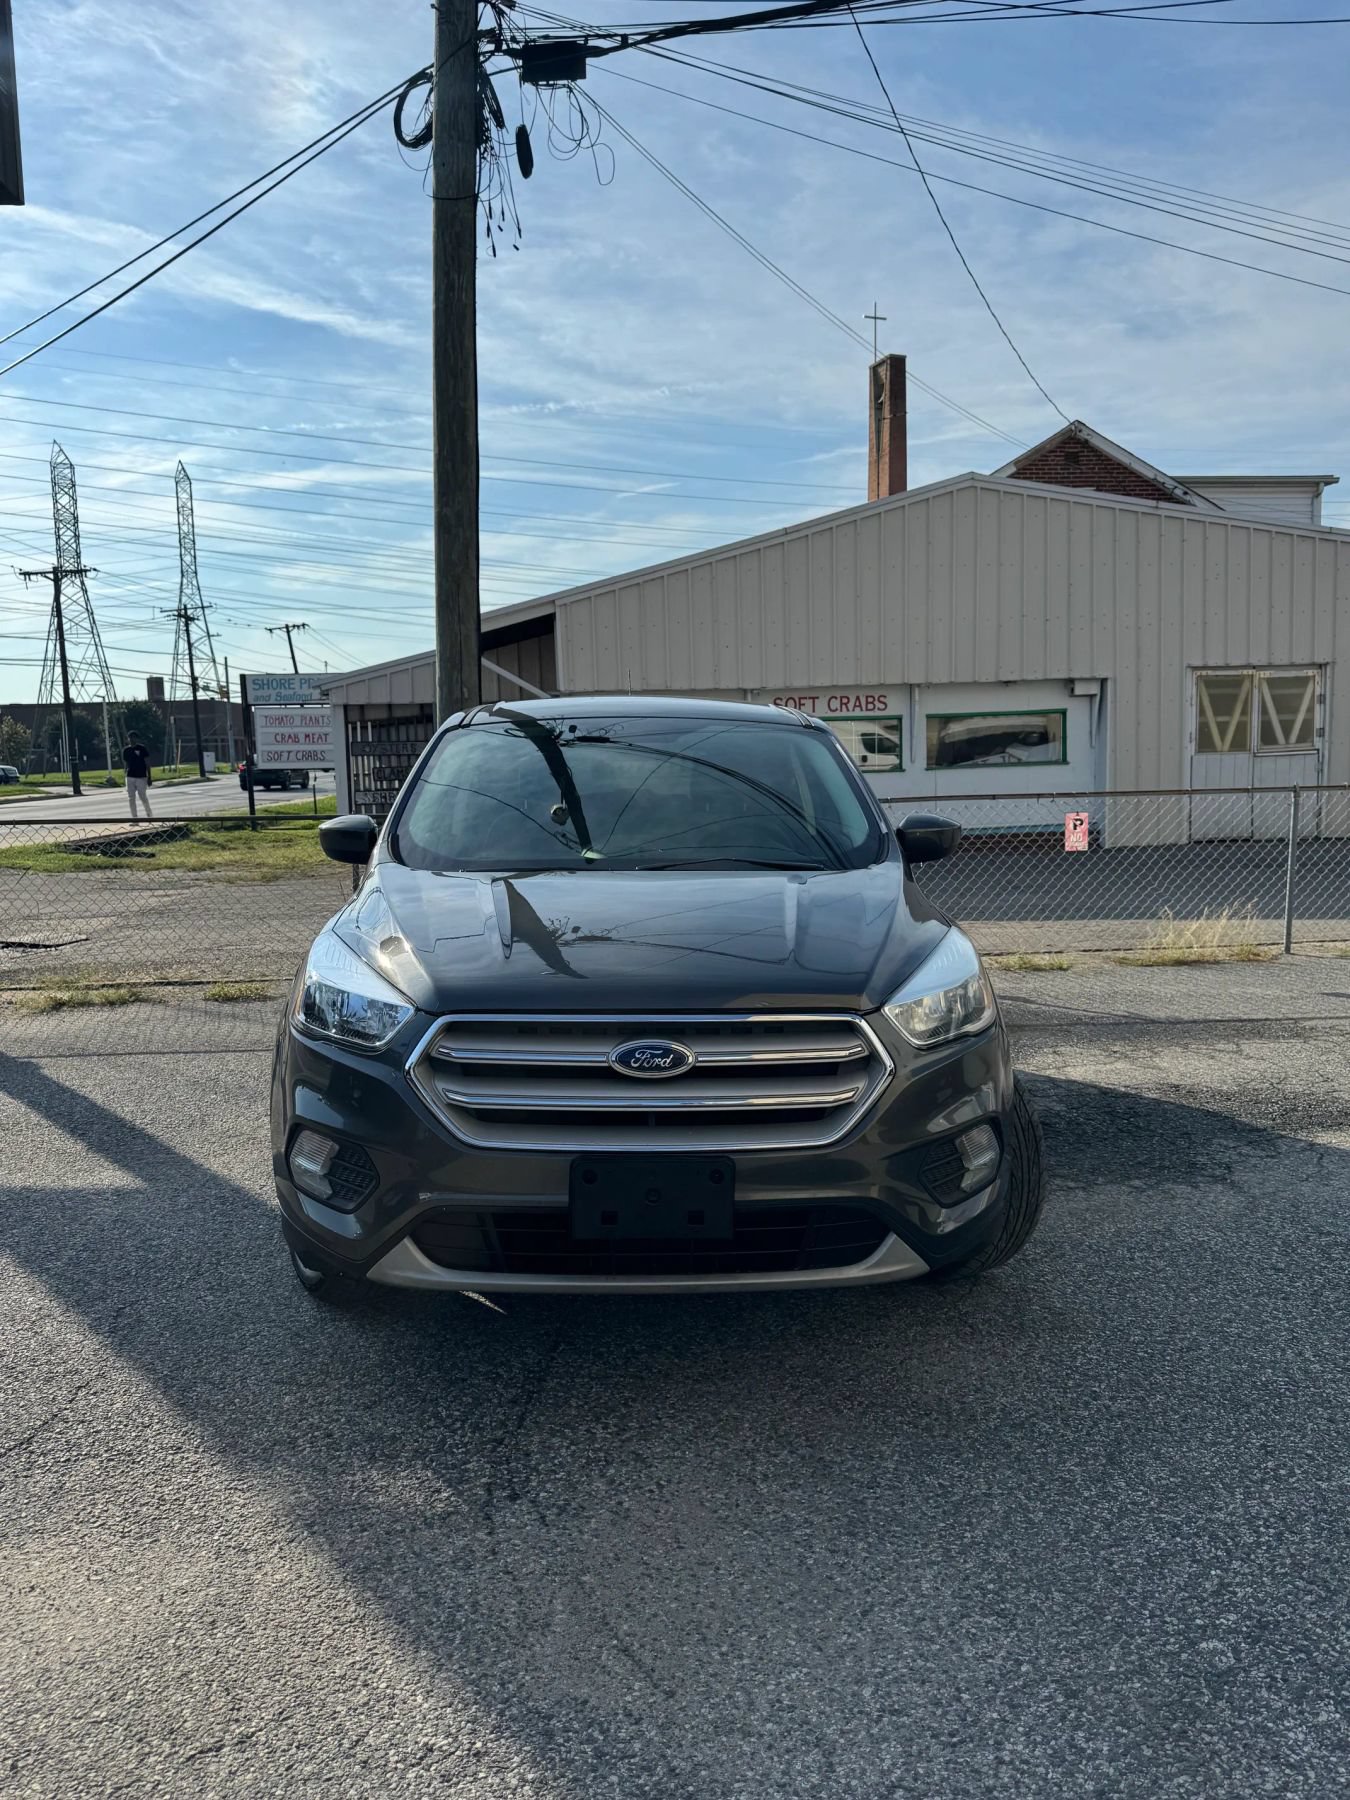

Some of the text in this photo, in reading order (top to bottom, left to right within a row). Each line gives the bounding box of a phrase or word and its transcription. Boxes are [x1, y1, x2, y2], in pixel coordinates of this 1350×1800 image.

[252, 677, 295, 691] SHORE
[253, 691, 313, 702] and Seafood
[773, 695, 888, 713] SOFT CRABS
[264, 715, 331, 726] TOMATO PLANTS
[274, 732, 329, 743] CRAB MEAT
[266, 750, 326, 761] SOFT CRABS
[1070, 832, 1083, 842] NO
[630, 1049, 674, 1067] Ford
